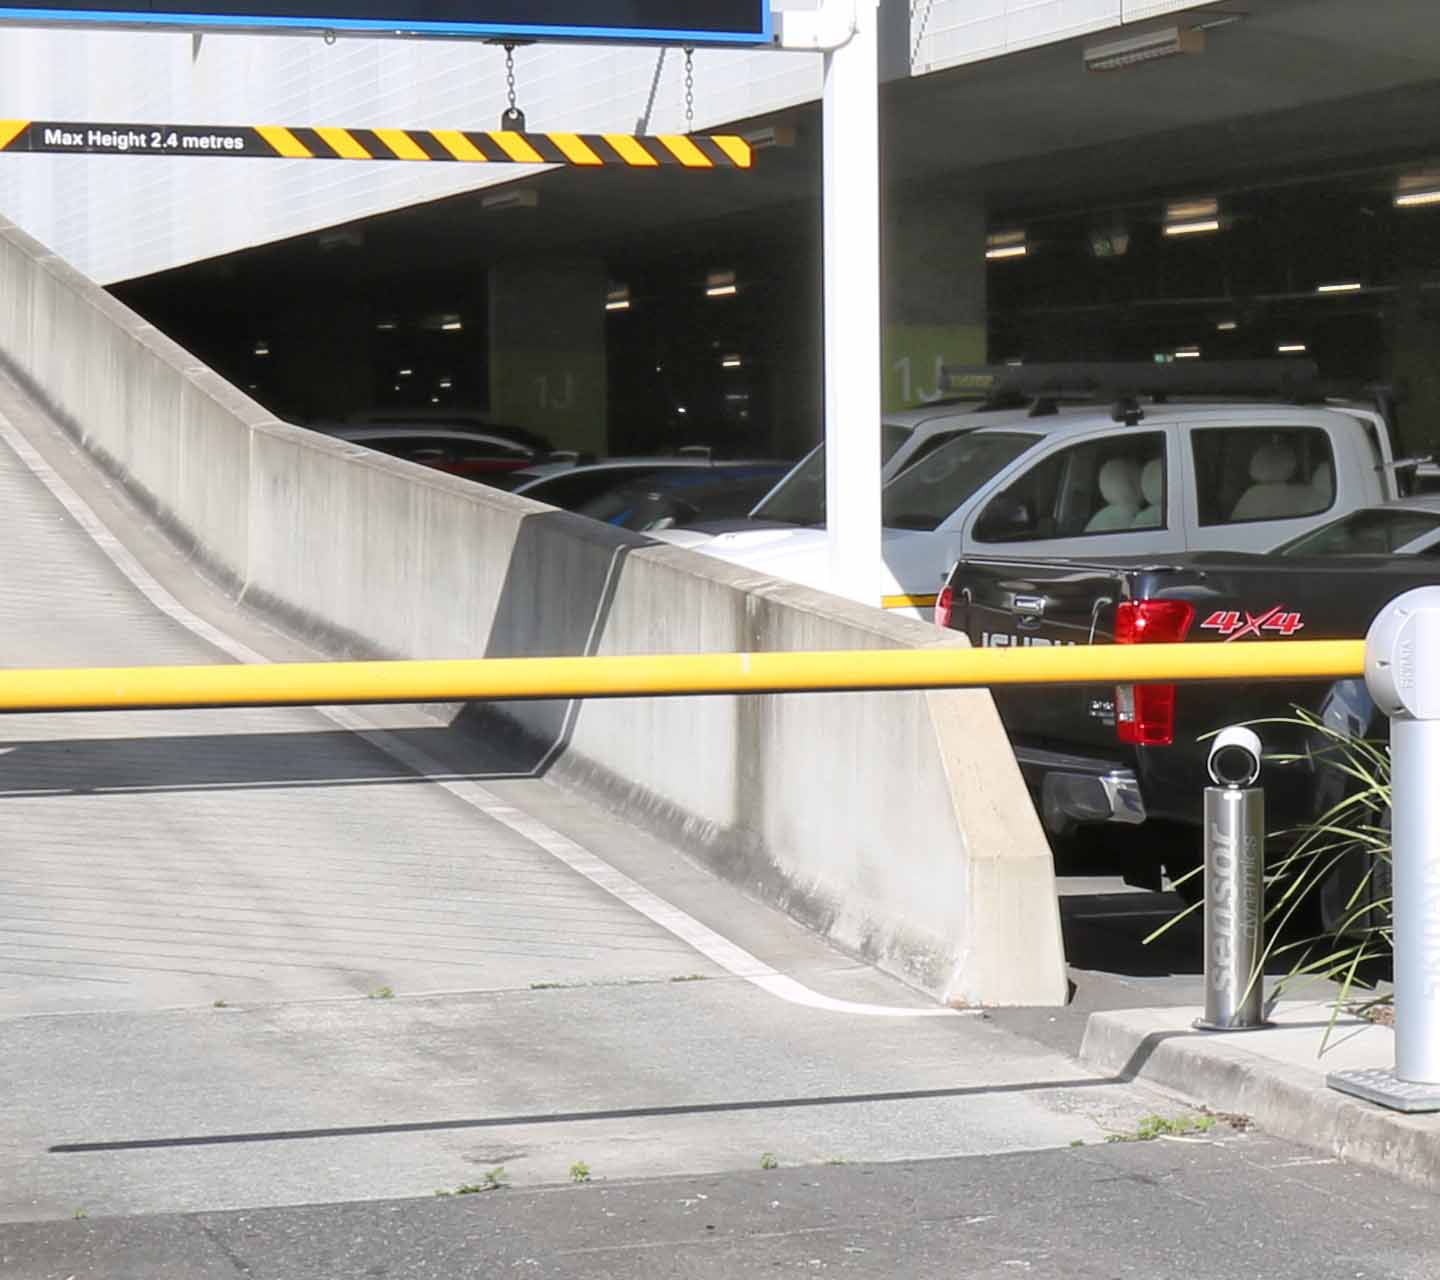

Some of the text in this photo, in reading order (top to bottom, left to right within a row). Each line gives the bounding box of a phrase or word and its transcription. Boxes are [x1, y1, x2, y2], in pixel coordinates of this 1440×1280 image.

[44, 128, 244, 150] Max Height 2.4 metres
[1210, 823, 1236, 992] sensor
